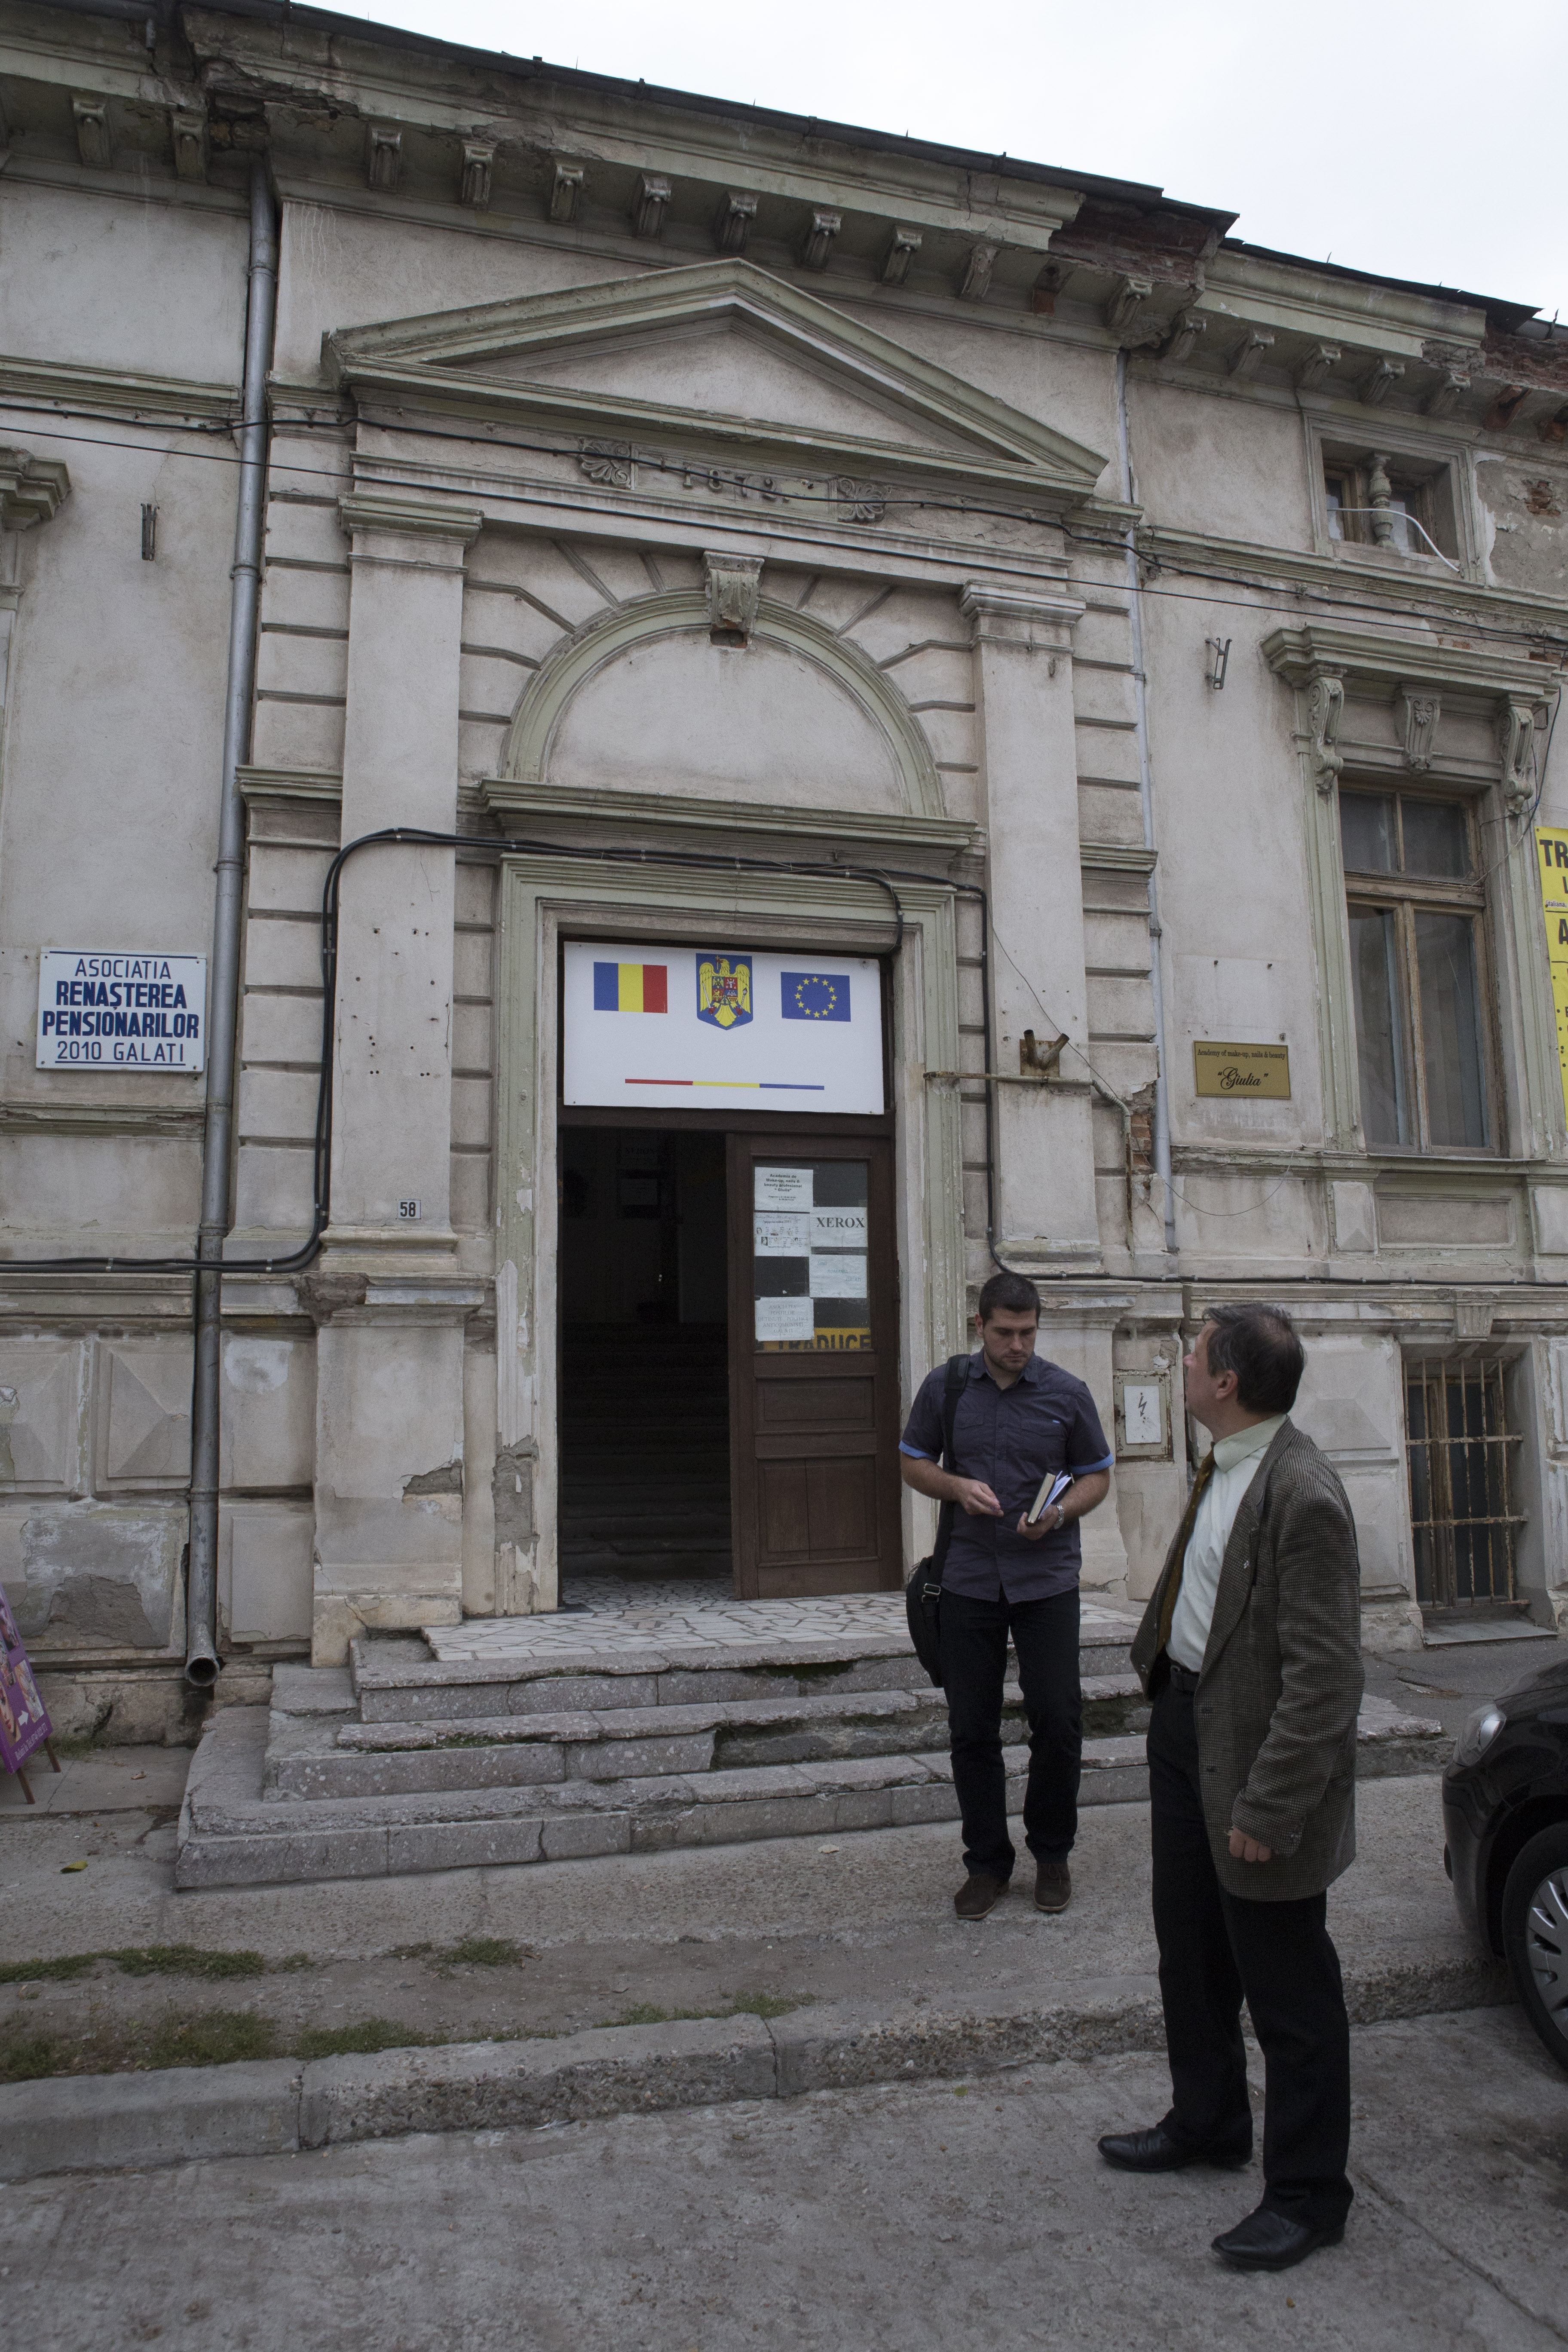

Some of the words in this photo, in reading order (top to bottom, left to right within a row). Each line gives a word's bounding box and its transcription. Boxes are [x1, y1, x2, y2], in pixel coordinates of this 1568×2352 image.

[42, 1011, 199, 1038] PENSIONARILOR
[58, 1041, 102, 1060] 2010
[1197, 1049, 1220, 1057] Academy
[1228, 1050, 1250, 1059] make-up,
[1269, 1052, 1285, 1060] beauty
[400, 1202, 416, 1217] 58
[816, 1217, 865, 1228] XEROX
